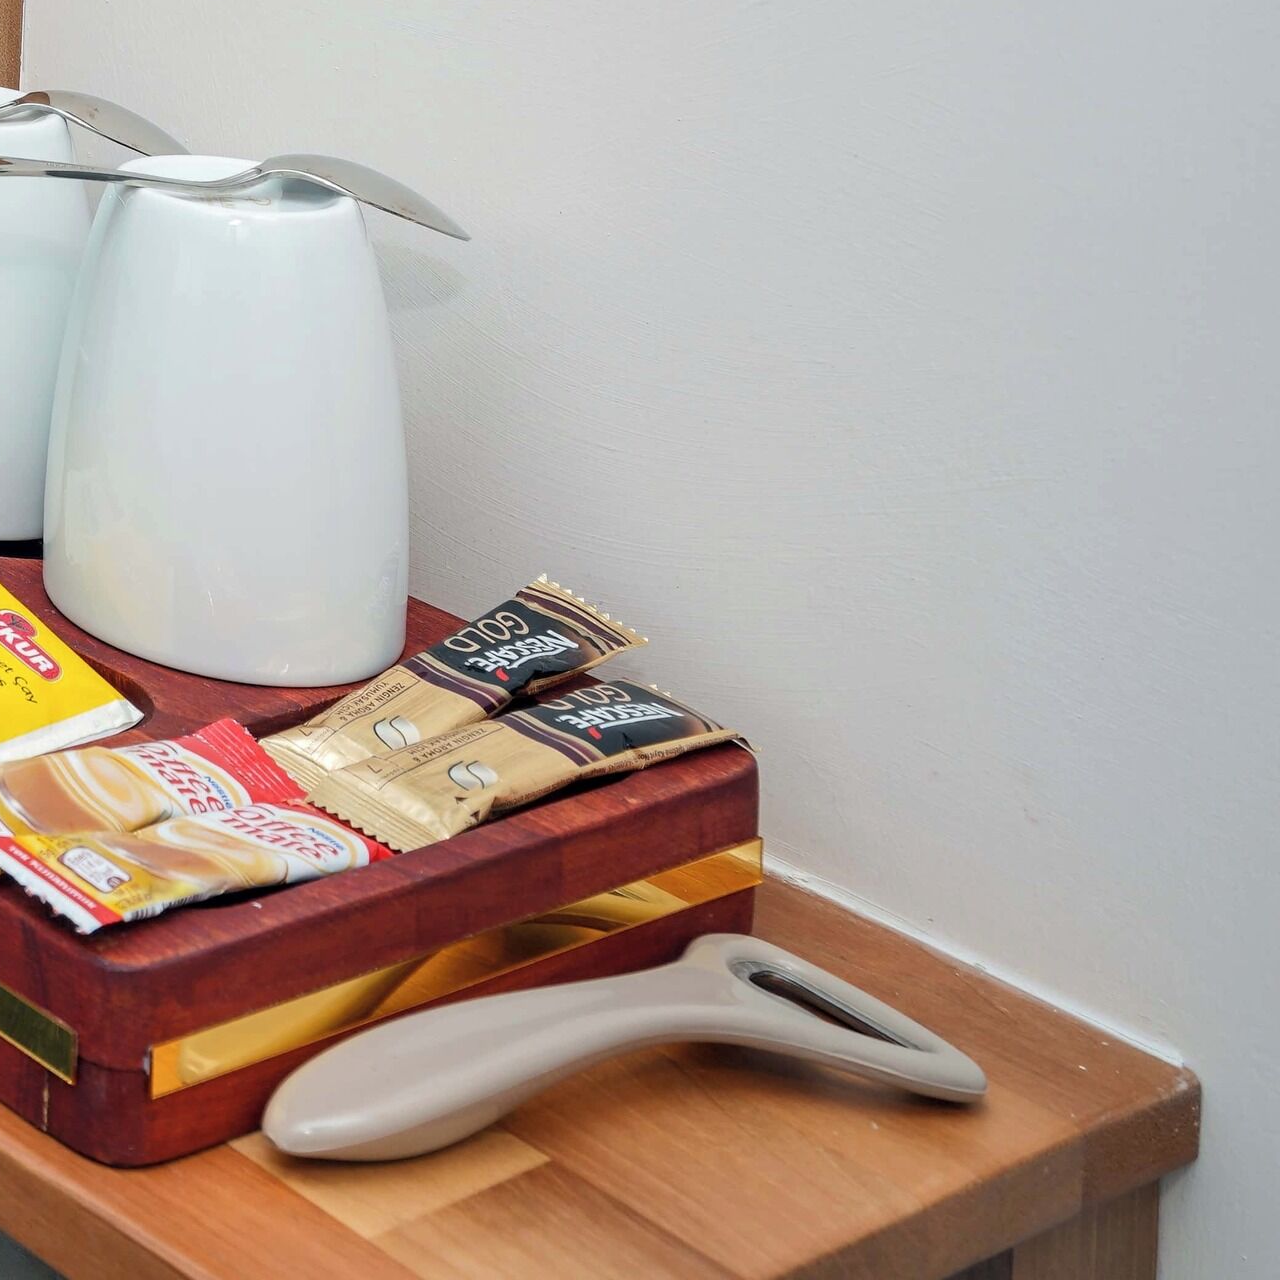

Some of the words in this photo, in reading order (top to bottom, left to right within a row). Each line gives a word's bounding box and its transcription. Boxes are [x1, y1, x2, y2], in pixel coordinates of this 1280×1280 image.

[443, 610, 532, 655] GOLD
[12, 675, 40, 705] Çay
[421, 742, 454, 759] AROMA
